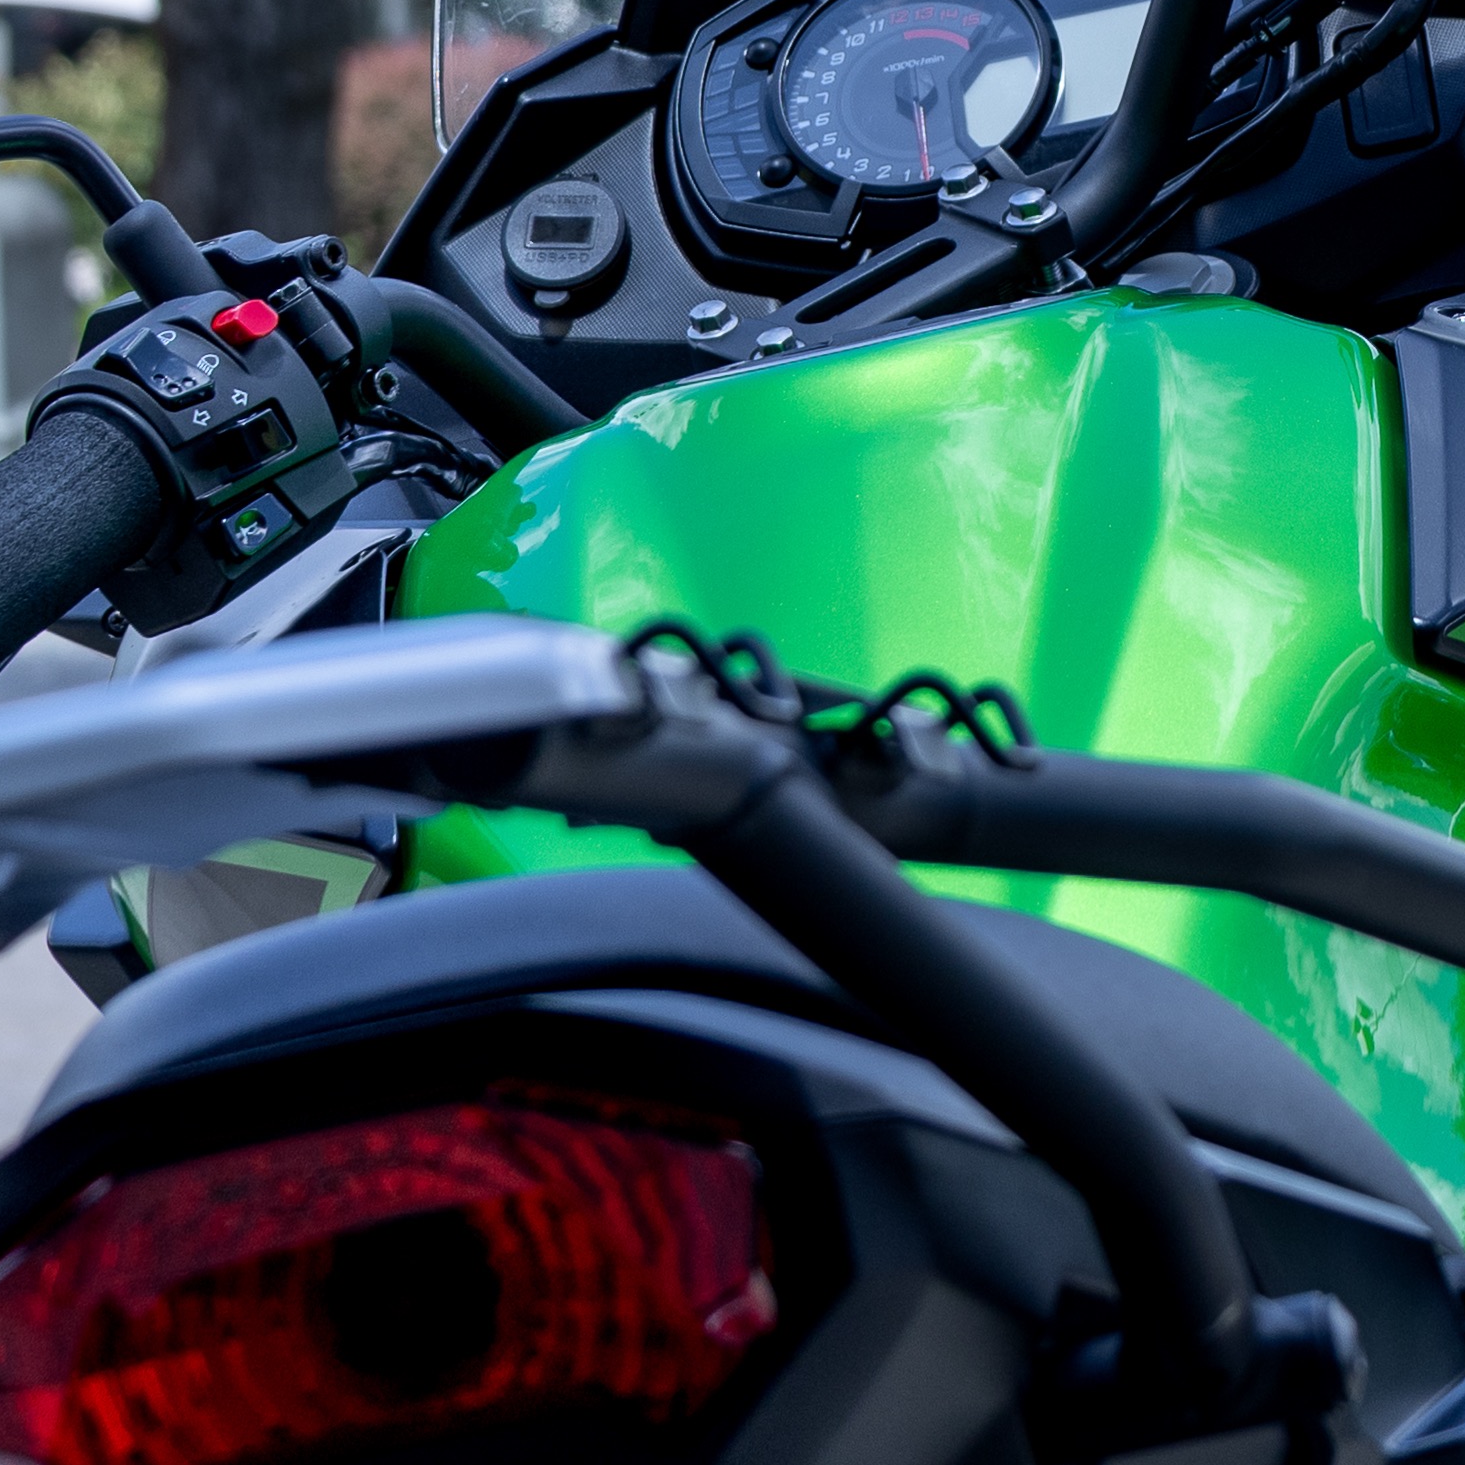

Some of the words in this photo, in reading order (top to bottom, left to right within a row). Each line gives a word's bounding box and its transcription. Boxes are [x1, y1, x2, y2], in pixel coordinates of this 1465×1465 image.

[889, 10, 909, 25] 12
[914, 6, 935, 21] 13
[939, 8, 959, 21] 14
[962, 12, 982, 27] 15
[869, 18, 885, 34] 11
[845, 33, 866, 48] 10
[830, 52, 846, 66] 9
[820, 70, 837, 85] 8
[815, 92, 829, 104] 7
[815, 112, 831, 126] 6
[822, 132, 837, 146] 5
[836, 147, 851, 160] 4
[853, 158, 869, 172] 3
[875, 164, 892, 180] 2
[903, 168, 911, 182] 1
